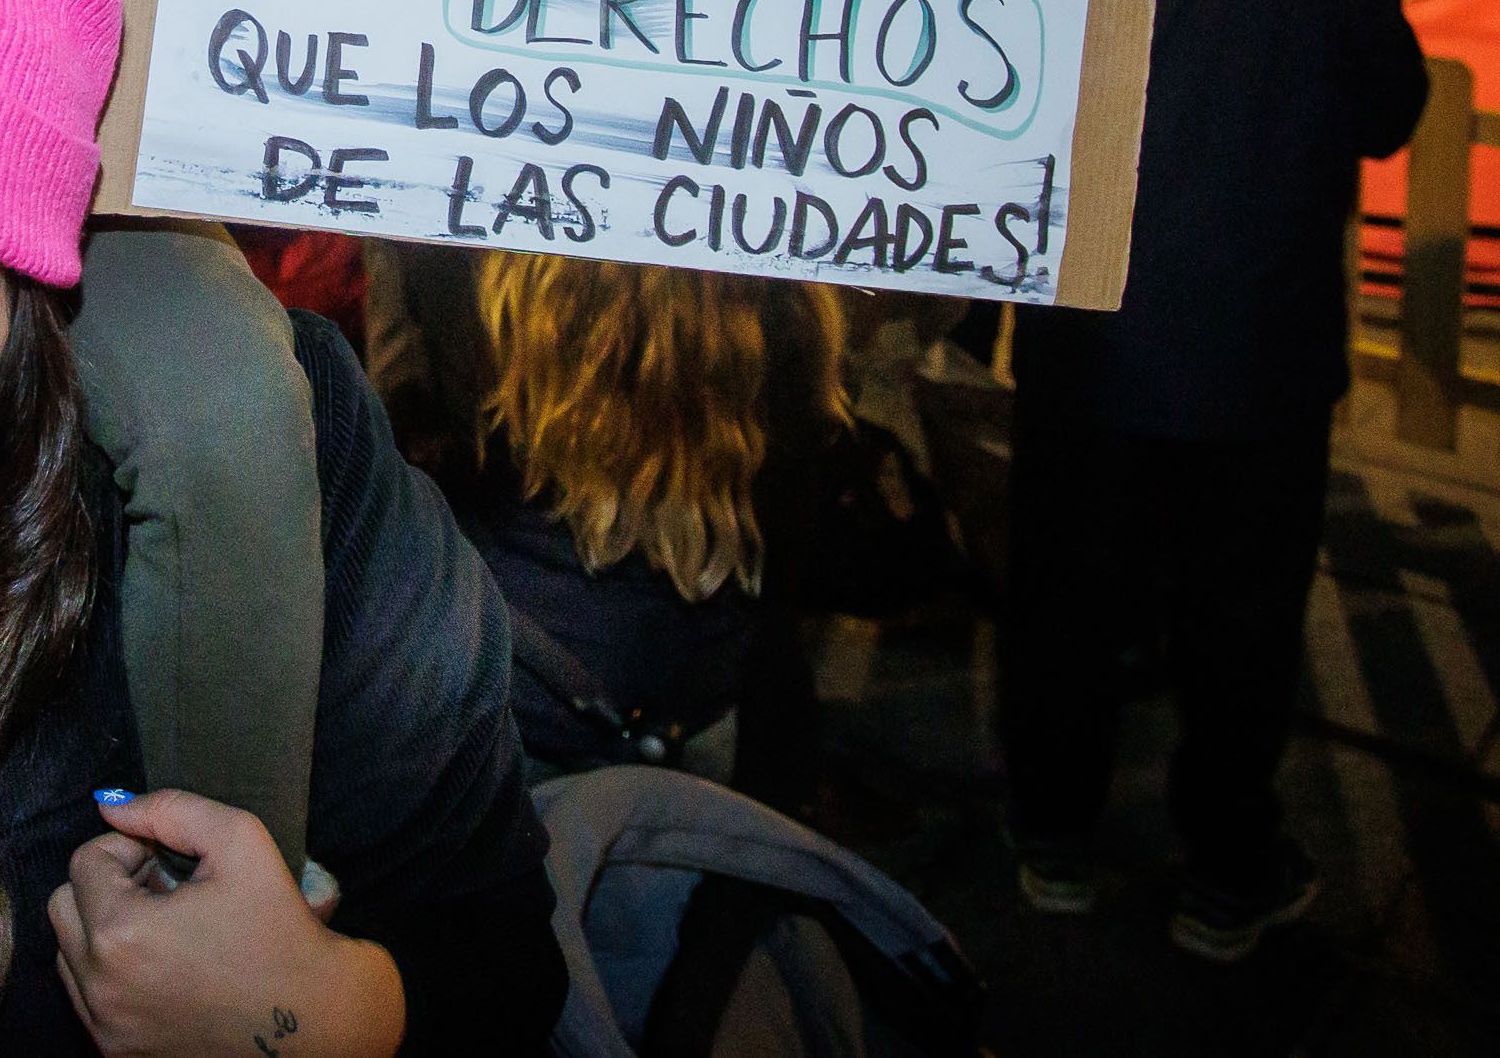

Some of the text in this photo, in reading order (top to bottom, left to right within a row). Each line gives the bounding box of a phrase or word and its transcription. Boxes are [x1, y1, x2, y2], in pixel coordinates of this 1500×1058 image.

[208, 9, 940, 191] QUE LOS NIÑOS
[263, 135, 1056, 288] DE LAS CIUDADES!
